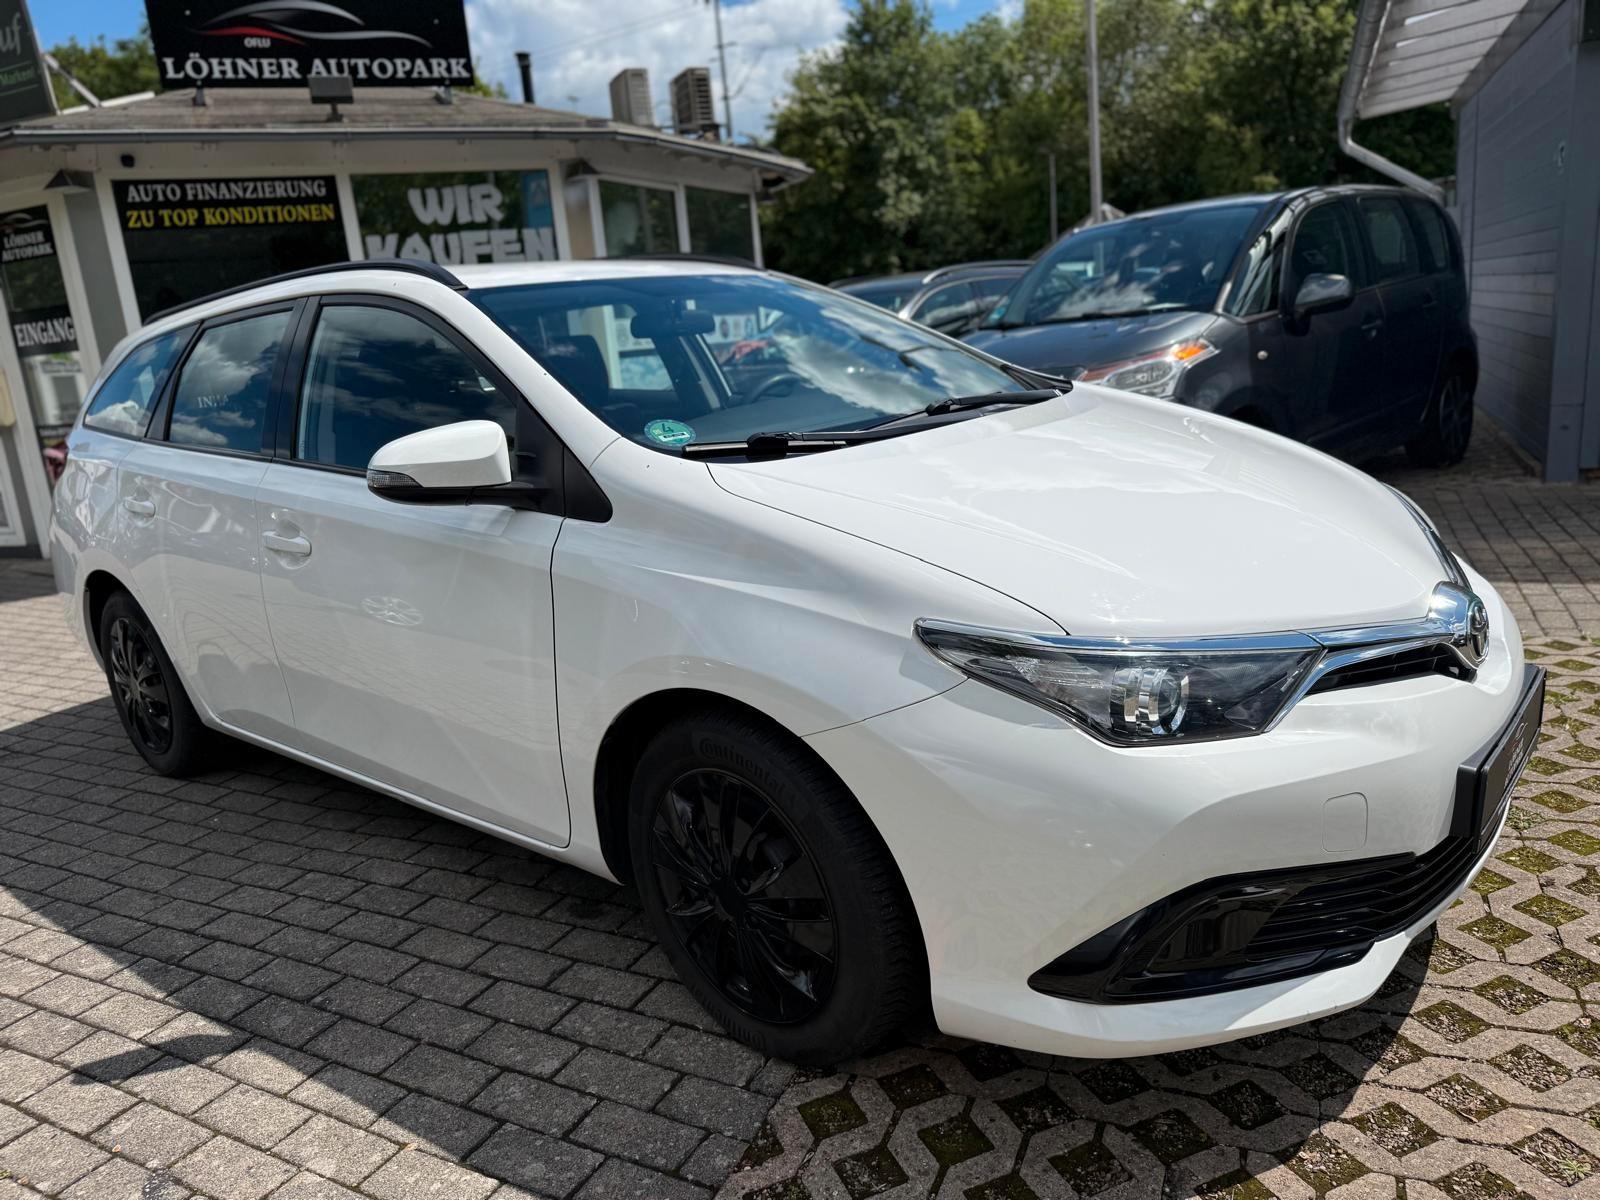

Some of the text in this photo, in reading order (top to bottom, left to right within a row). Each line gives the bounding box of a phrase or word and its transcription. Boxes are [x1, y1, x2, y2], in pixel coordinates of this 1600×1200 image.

[162, 52, 472, 79] LÖHNER AUTOPARK
[127, 179, 327, 202] AUTO FINANZIERUNG
[126, 204, 335, 229] ZU TOP KONDITIONEN
[407, 183, 505, 226] WIR
[2, 242, 54, 262] AUTOPARK
[3, 230, 45, 249] LÖHNER
[365, 228, 559, 264] KAUFEN
[14, 316, 77, 348] EINGANG
